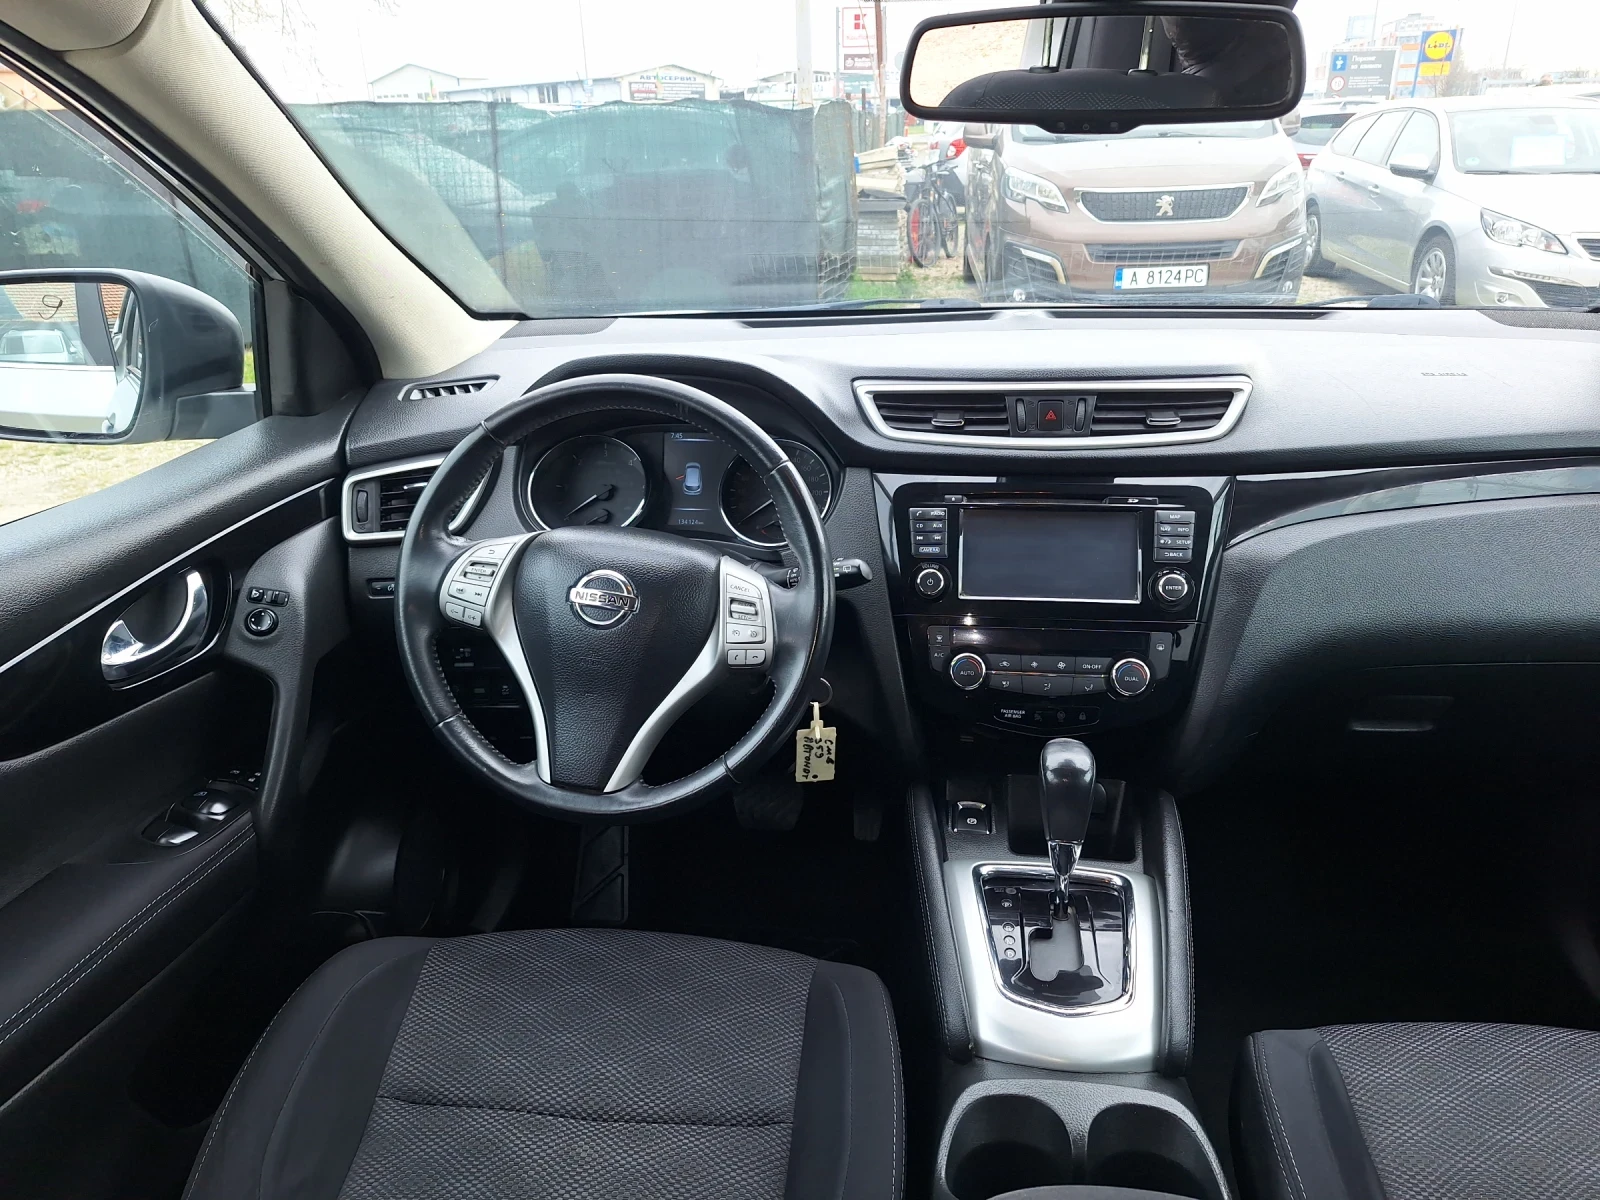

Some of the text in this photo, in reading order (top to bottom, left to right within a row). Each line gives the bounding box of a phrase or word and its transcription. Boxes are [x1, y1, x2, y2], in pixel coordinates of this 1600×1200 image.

[1130, 271, 1138, 286] A
[730, 584, 750, 593] CANCEL
[575, 591, 630, 607] NISSAN
